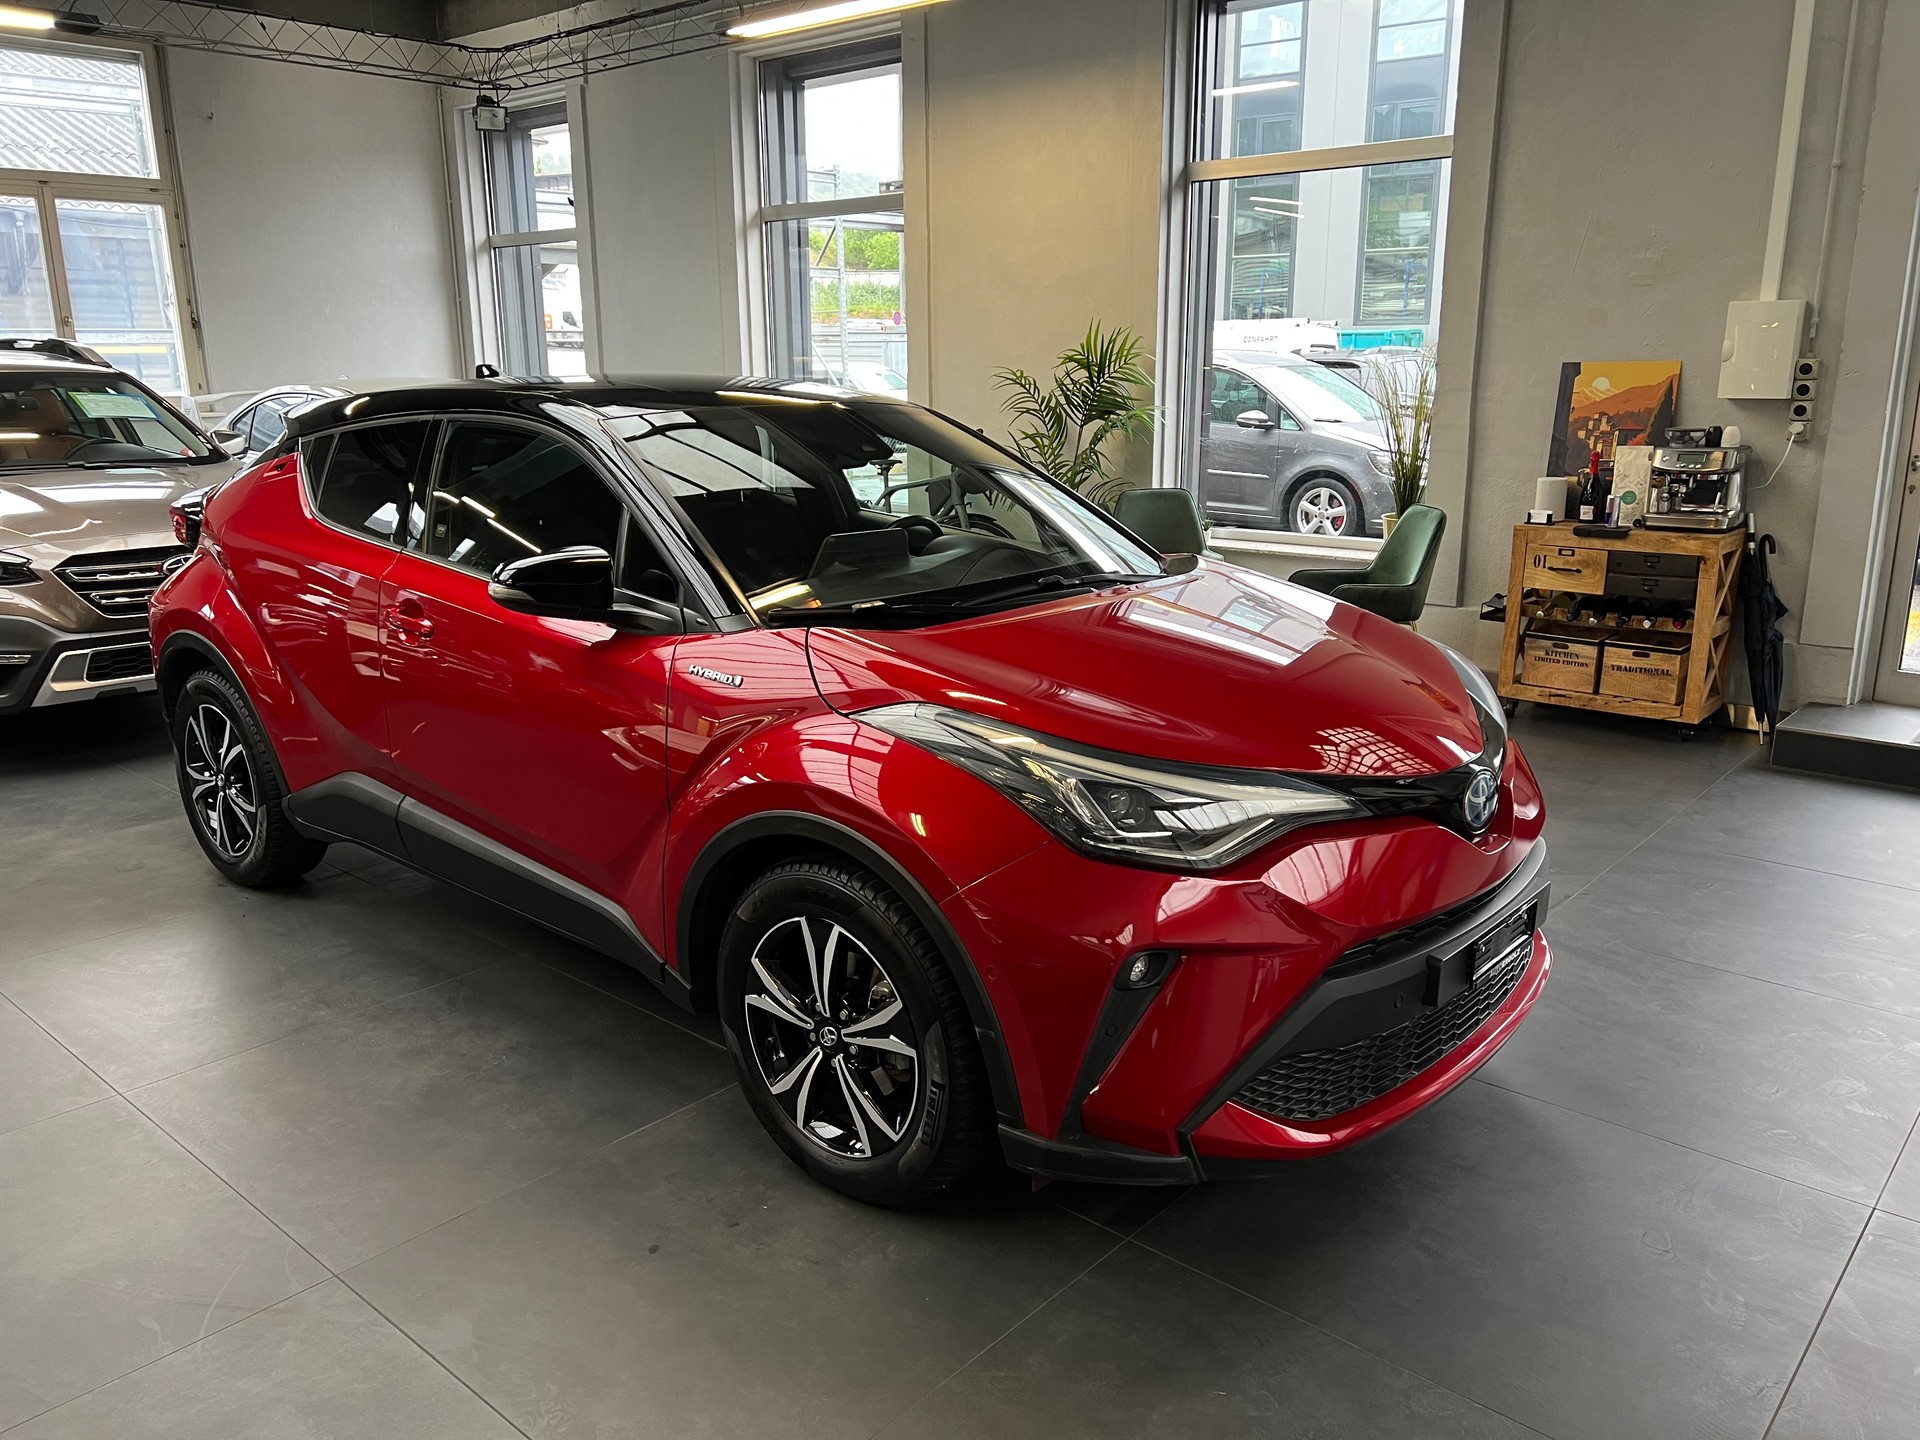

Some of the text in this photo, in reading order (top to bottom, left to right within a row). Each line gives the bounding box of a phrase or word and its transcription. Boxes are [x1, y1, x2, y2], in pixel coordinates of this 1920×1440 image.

[1243, 335, 1278, 343] EINFAHRT
[1533, 554, 1547, 568] 01
[1544, 649, 1580, 660] KITCHEN
[1534, 656, 1589, 668] LIMITED EDITION
[689, 664, 733, 685] HYBRID
[1611, 664, 1672, 676] TRADITIONAL
[921, 1079, 945, 1149] PIRELLI
